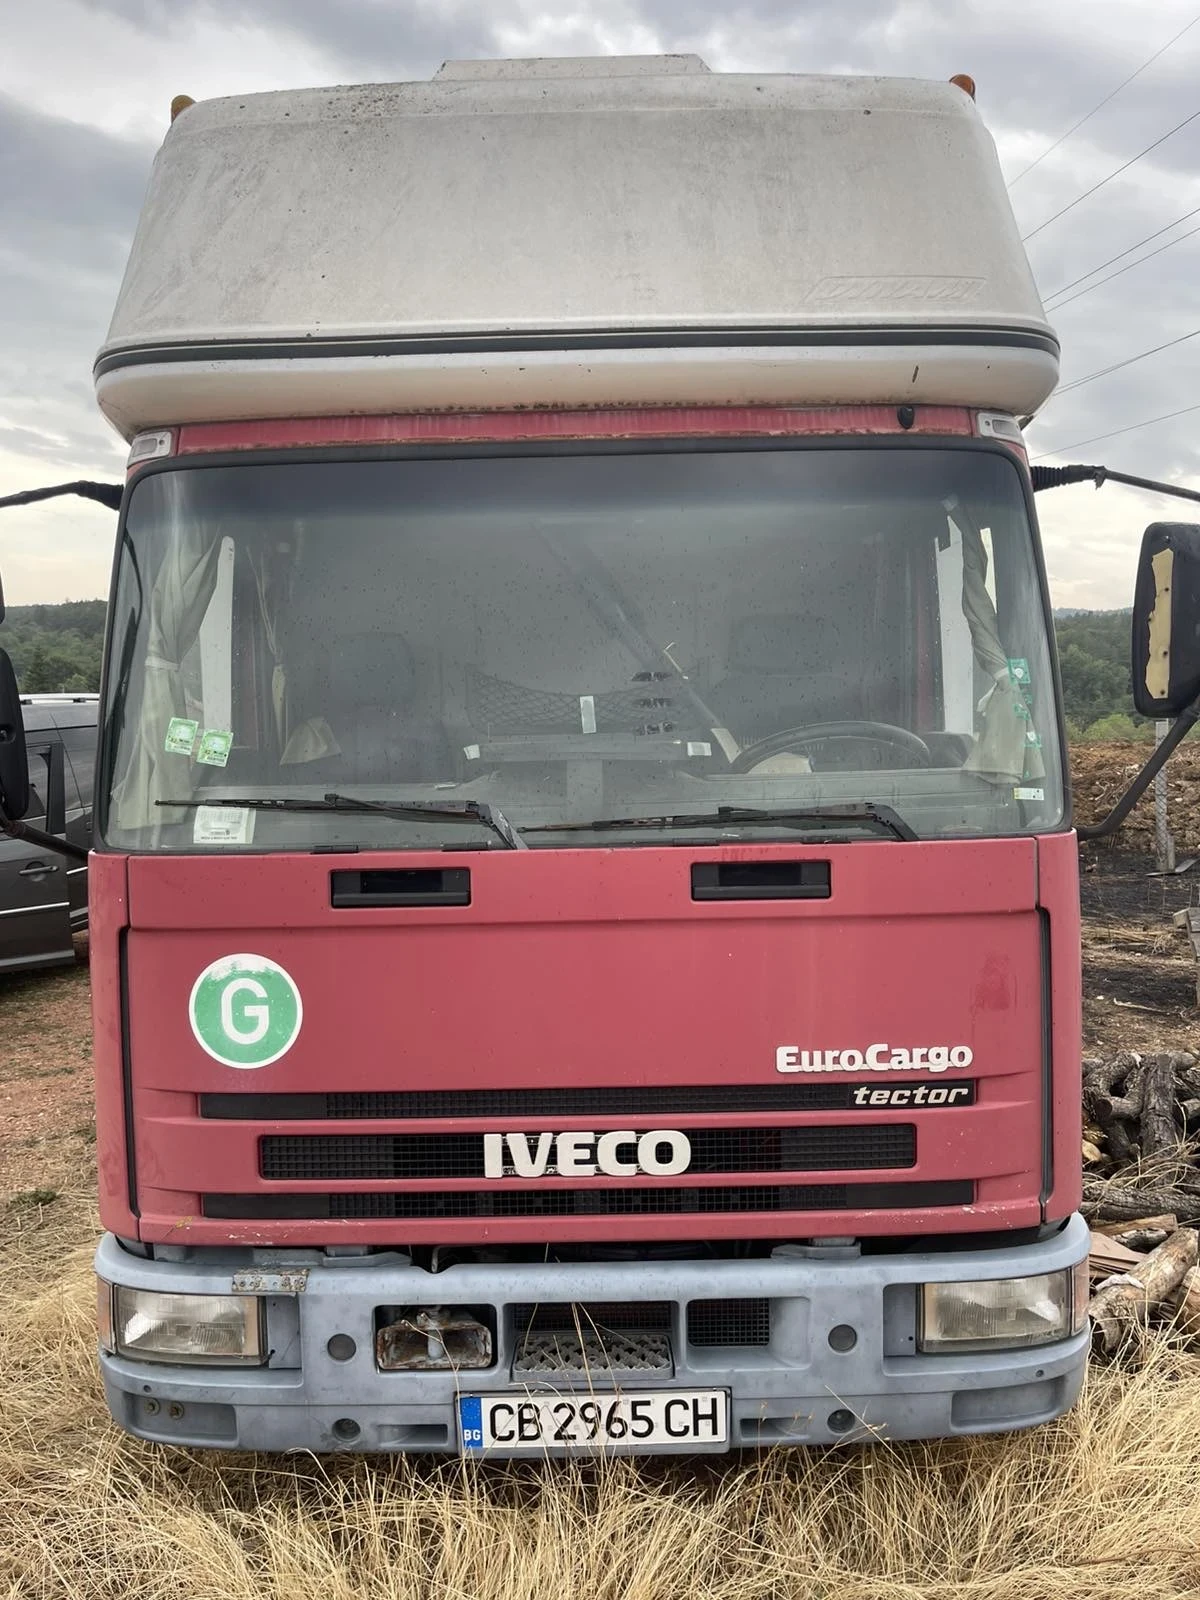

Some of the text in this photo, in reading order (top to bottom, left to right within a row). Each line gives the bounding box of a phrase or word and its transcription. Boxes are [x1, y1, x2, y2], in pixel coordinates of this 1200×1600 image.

[221, 977, 270, 1045] G
[776, 1043, 974, 1073] EuroCargo
[853, 1085, 969, 1105] tector
[483, 1130, 691, 1178] IVECO
[463, 1428, 482, 1441] BG
[489, 1397, 719, 1442] CB 2965 CH
